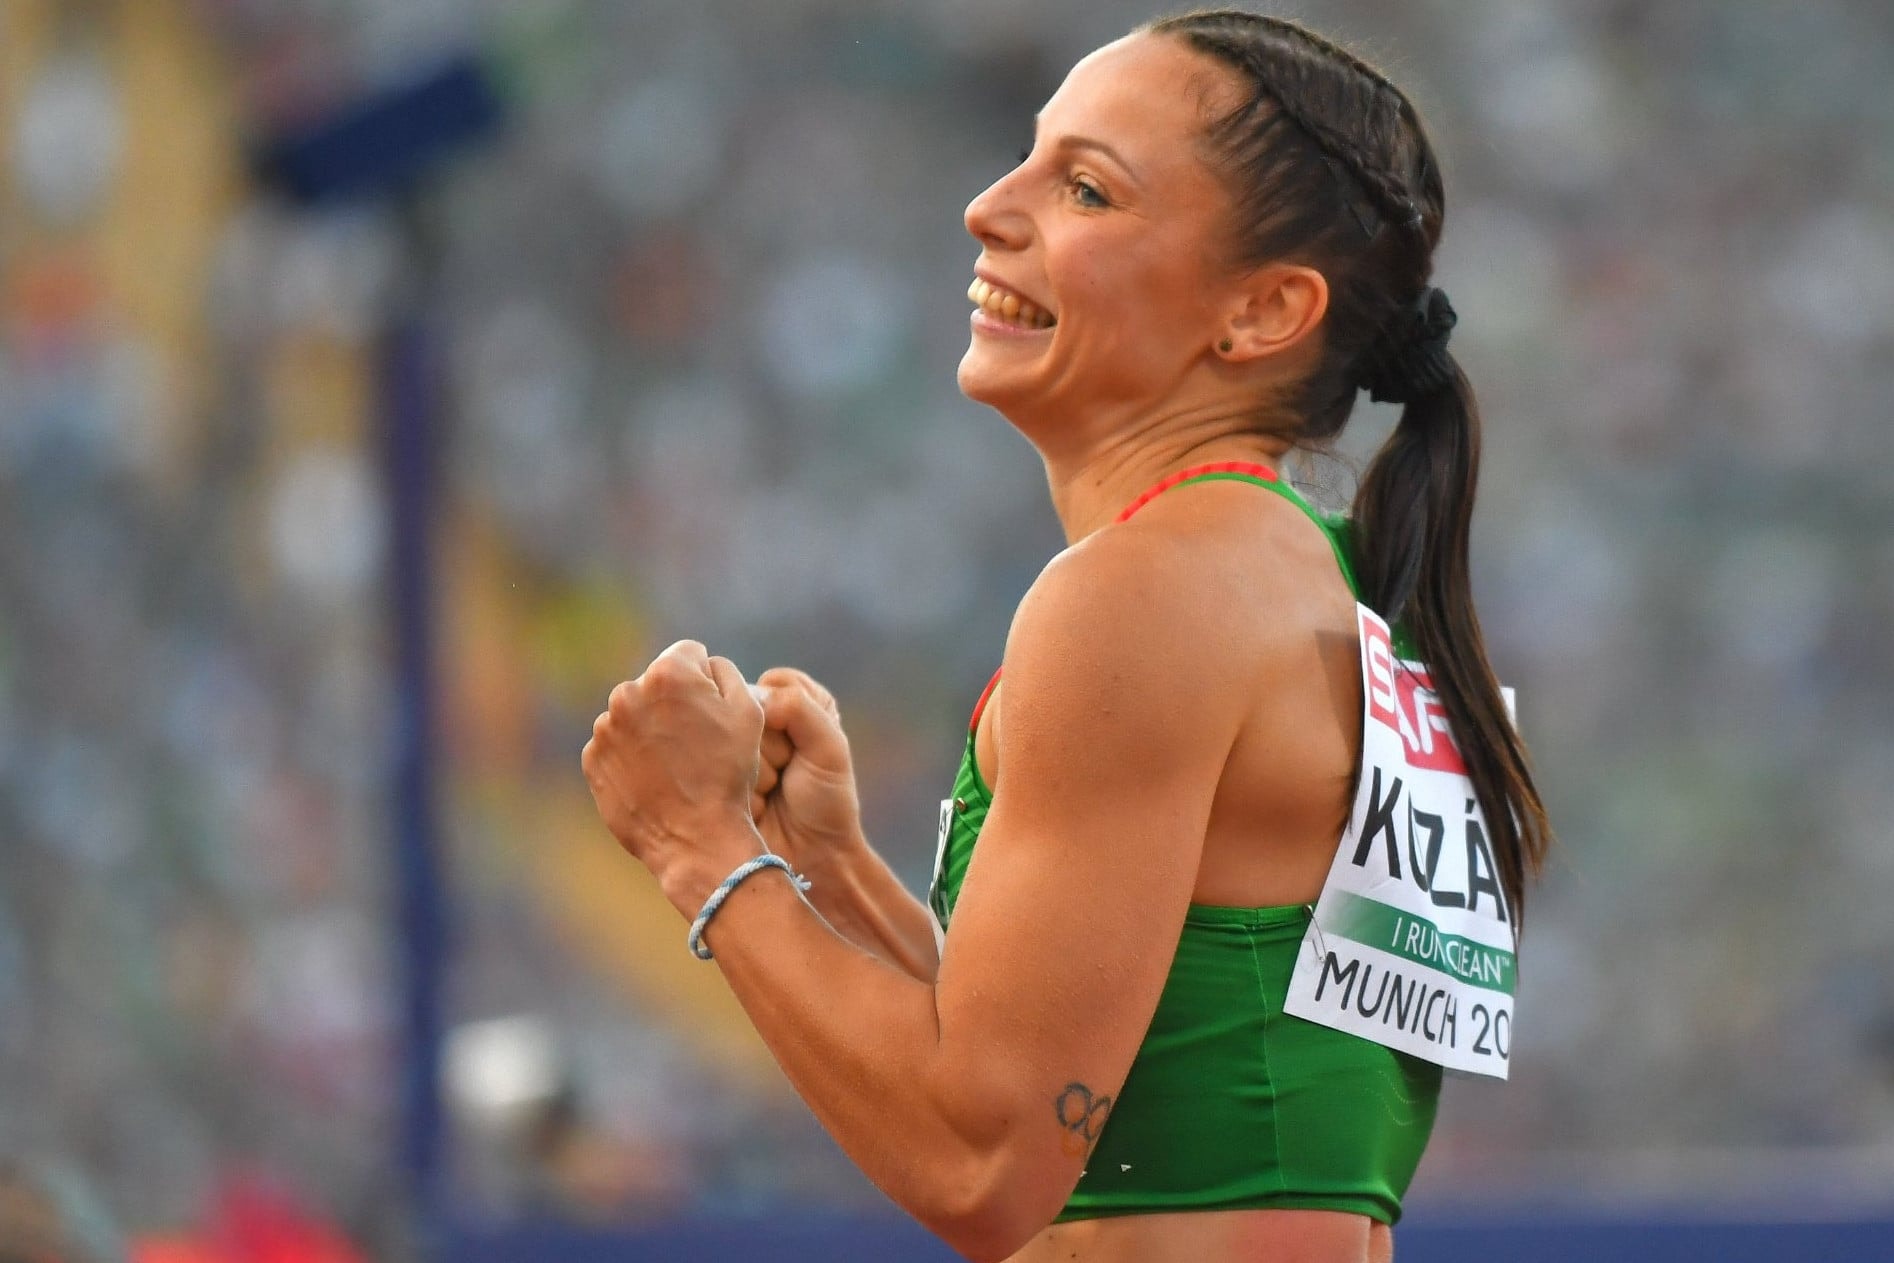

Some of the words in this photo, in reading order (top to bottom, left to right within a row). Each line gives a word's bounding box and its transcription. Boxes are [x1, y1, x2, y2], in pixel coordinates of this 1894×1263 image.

[1391, 917, 1402, 948] I
[1404, 921, 1447, 967] RUN
[1314, 951, 1457, 1049] MUNICH
